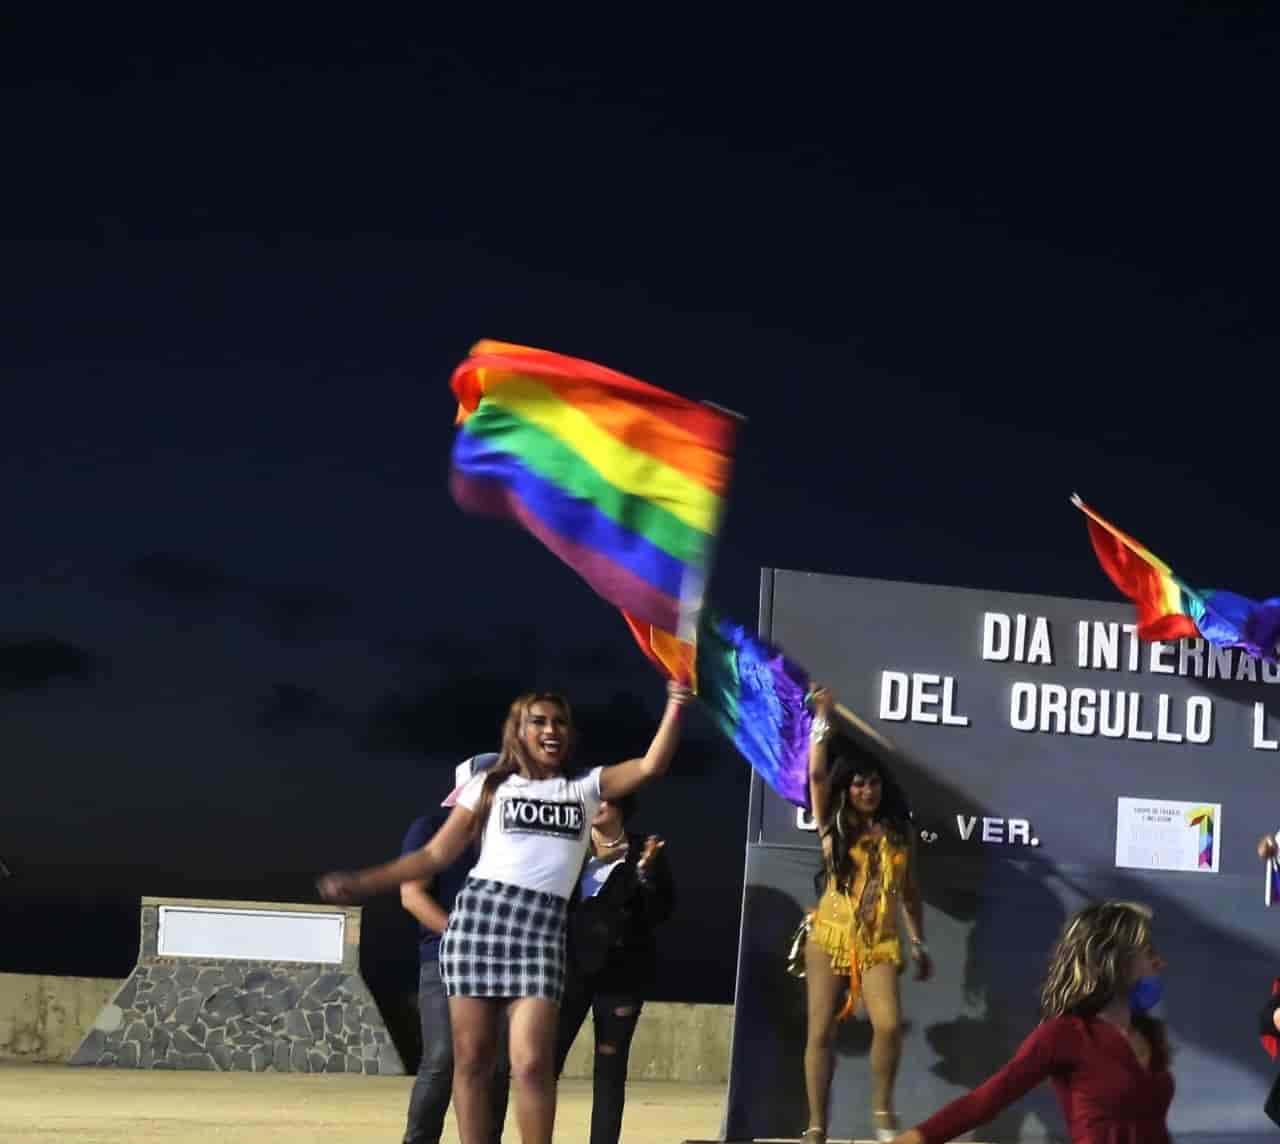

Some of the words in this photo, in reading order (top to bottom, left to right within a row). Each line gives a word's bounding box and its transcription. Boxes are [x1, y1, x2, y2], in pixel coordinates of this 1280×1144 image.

[982, 611, 1053, 665] DIA
[879, 669, 969, 726] DEL
[1009, 681, 1214, 744] ORGULLO
[505, 800, 582, 829] VOGUE
[956, 813, 1041, 847] VER.
